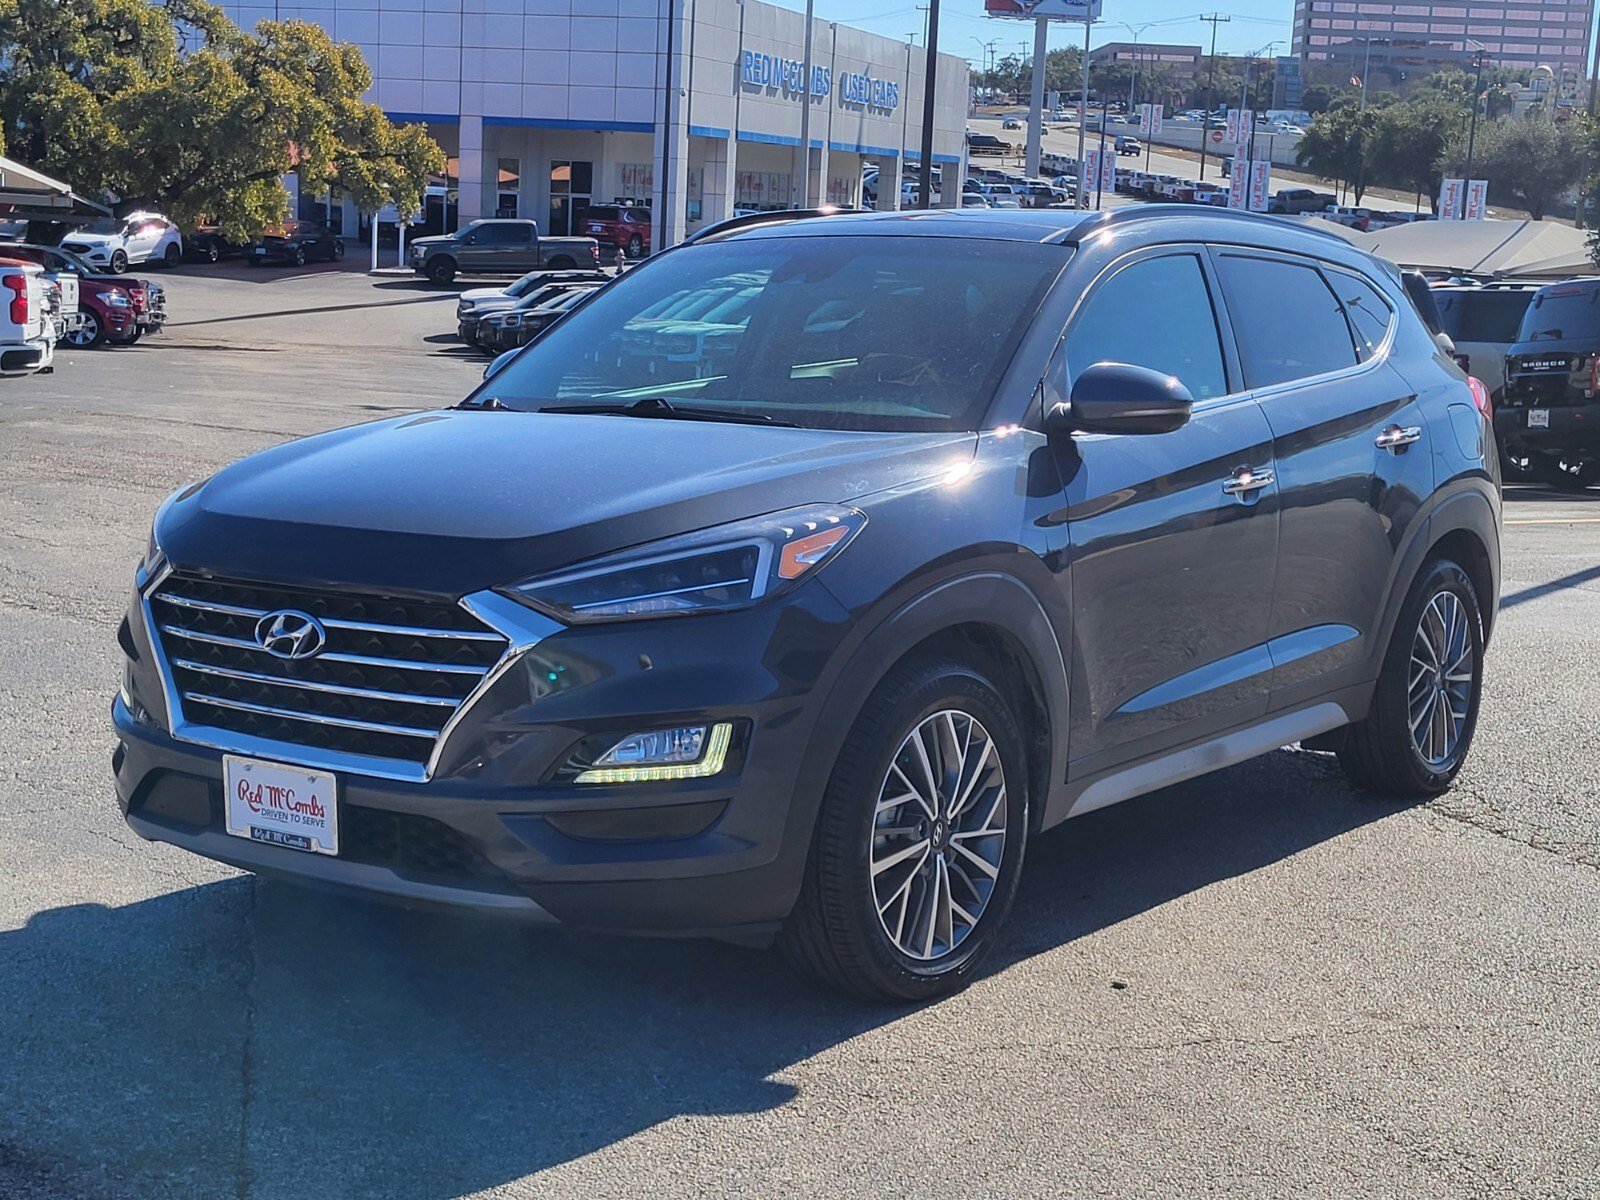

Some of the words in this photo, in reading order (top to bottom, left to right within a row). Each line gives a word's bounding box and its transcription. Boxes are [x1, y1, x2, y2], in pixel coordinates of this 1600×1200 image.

[743, 50, 769, 86] RED
[844, 73, 871, 103] USED
[874, 79, 898, 109] CARS
[237, 779, 263, 812] Red
[265, 785, 325, 817] McCombs
[261, 807, 289, 821] DRIVEN
[290, 813, 301, 824] TO
[302, 816, 326, 829] SERVE
[254, 828, 271, 841] Red
